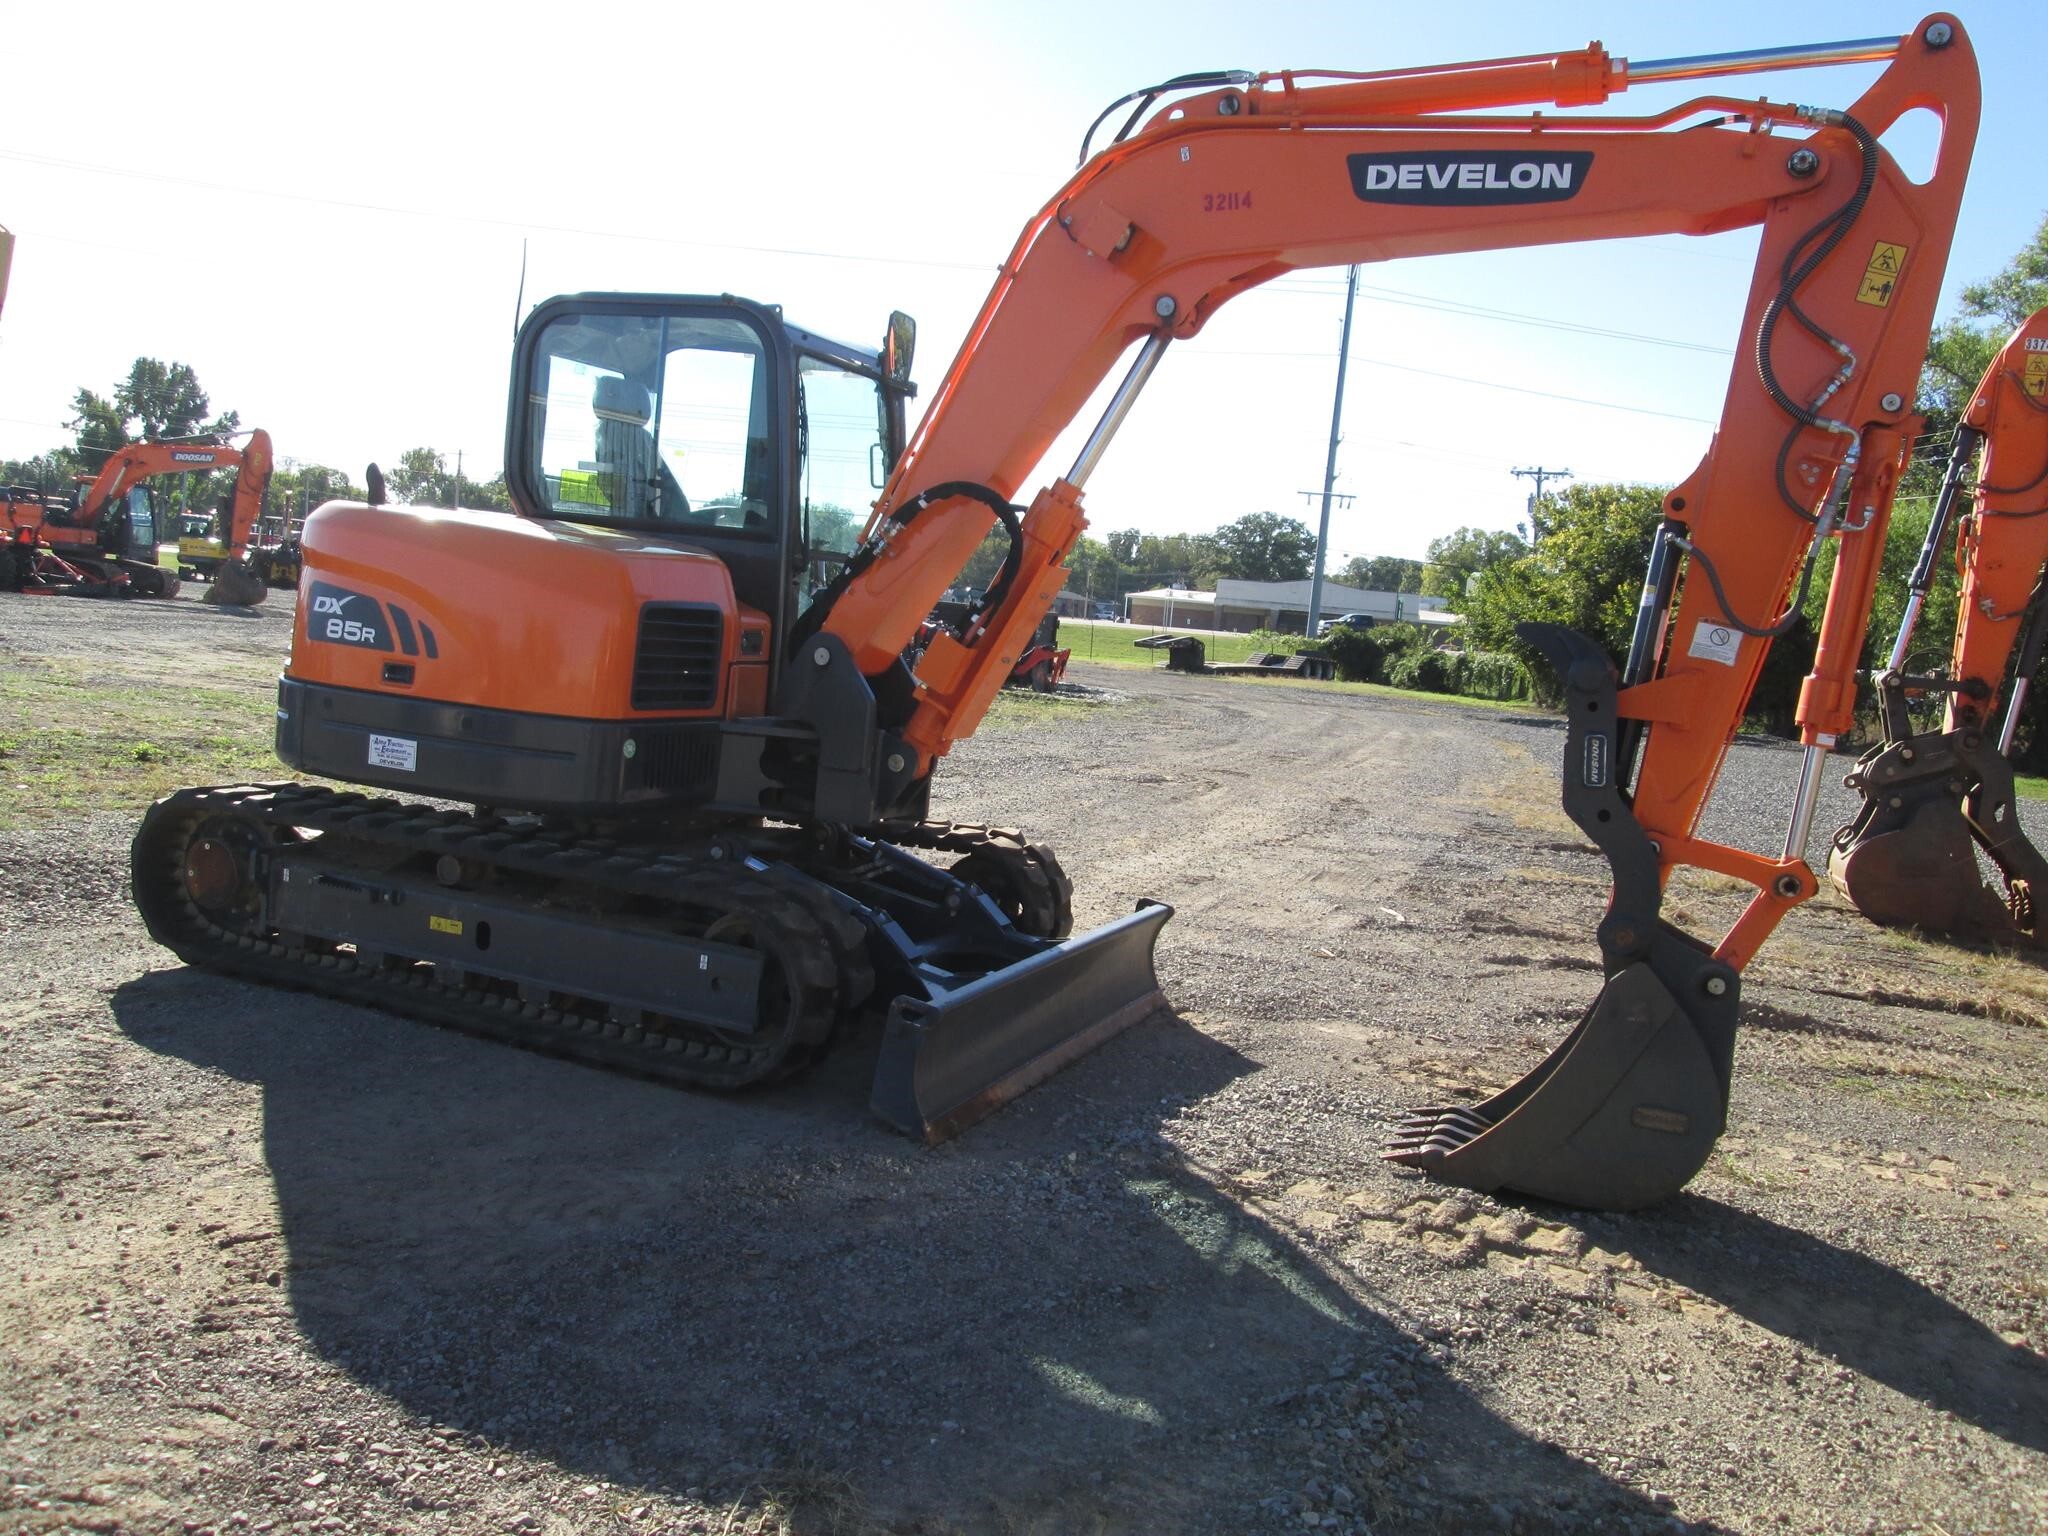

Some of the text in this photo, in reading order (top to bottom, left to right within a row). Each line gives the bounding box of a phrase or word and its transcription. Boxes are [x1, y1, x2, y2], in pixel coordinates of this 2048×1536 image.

[1366, 163, 1572, 190] DEVELON
[1204, 191, 1252, 212] 32114
[2026, 338, 2048, 351] 337
[175, 453, 214, 462] DOOSAN
[313, 595, 357, 615] DX
[326, 618, 376, 643] 85R
[1591, 739, 1600, 783] DOOSAN
